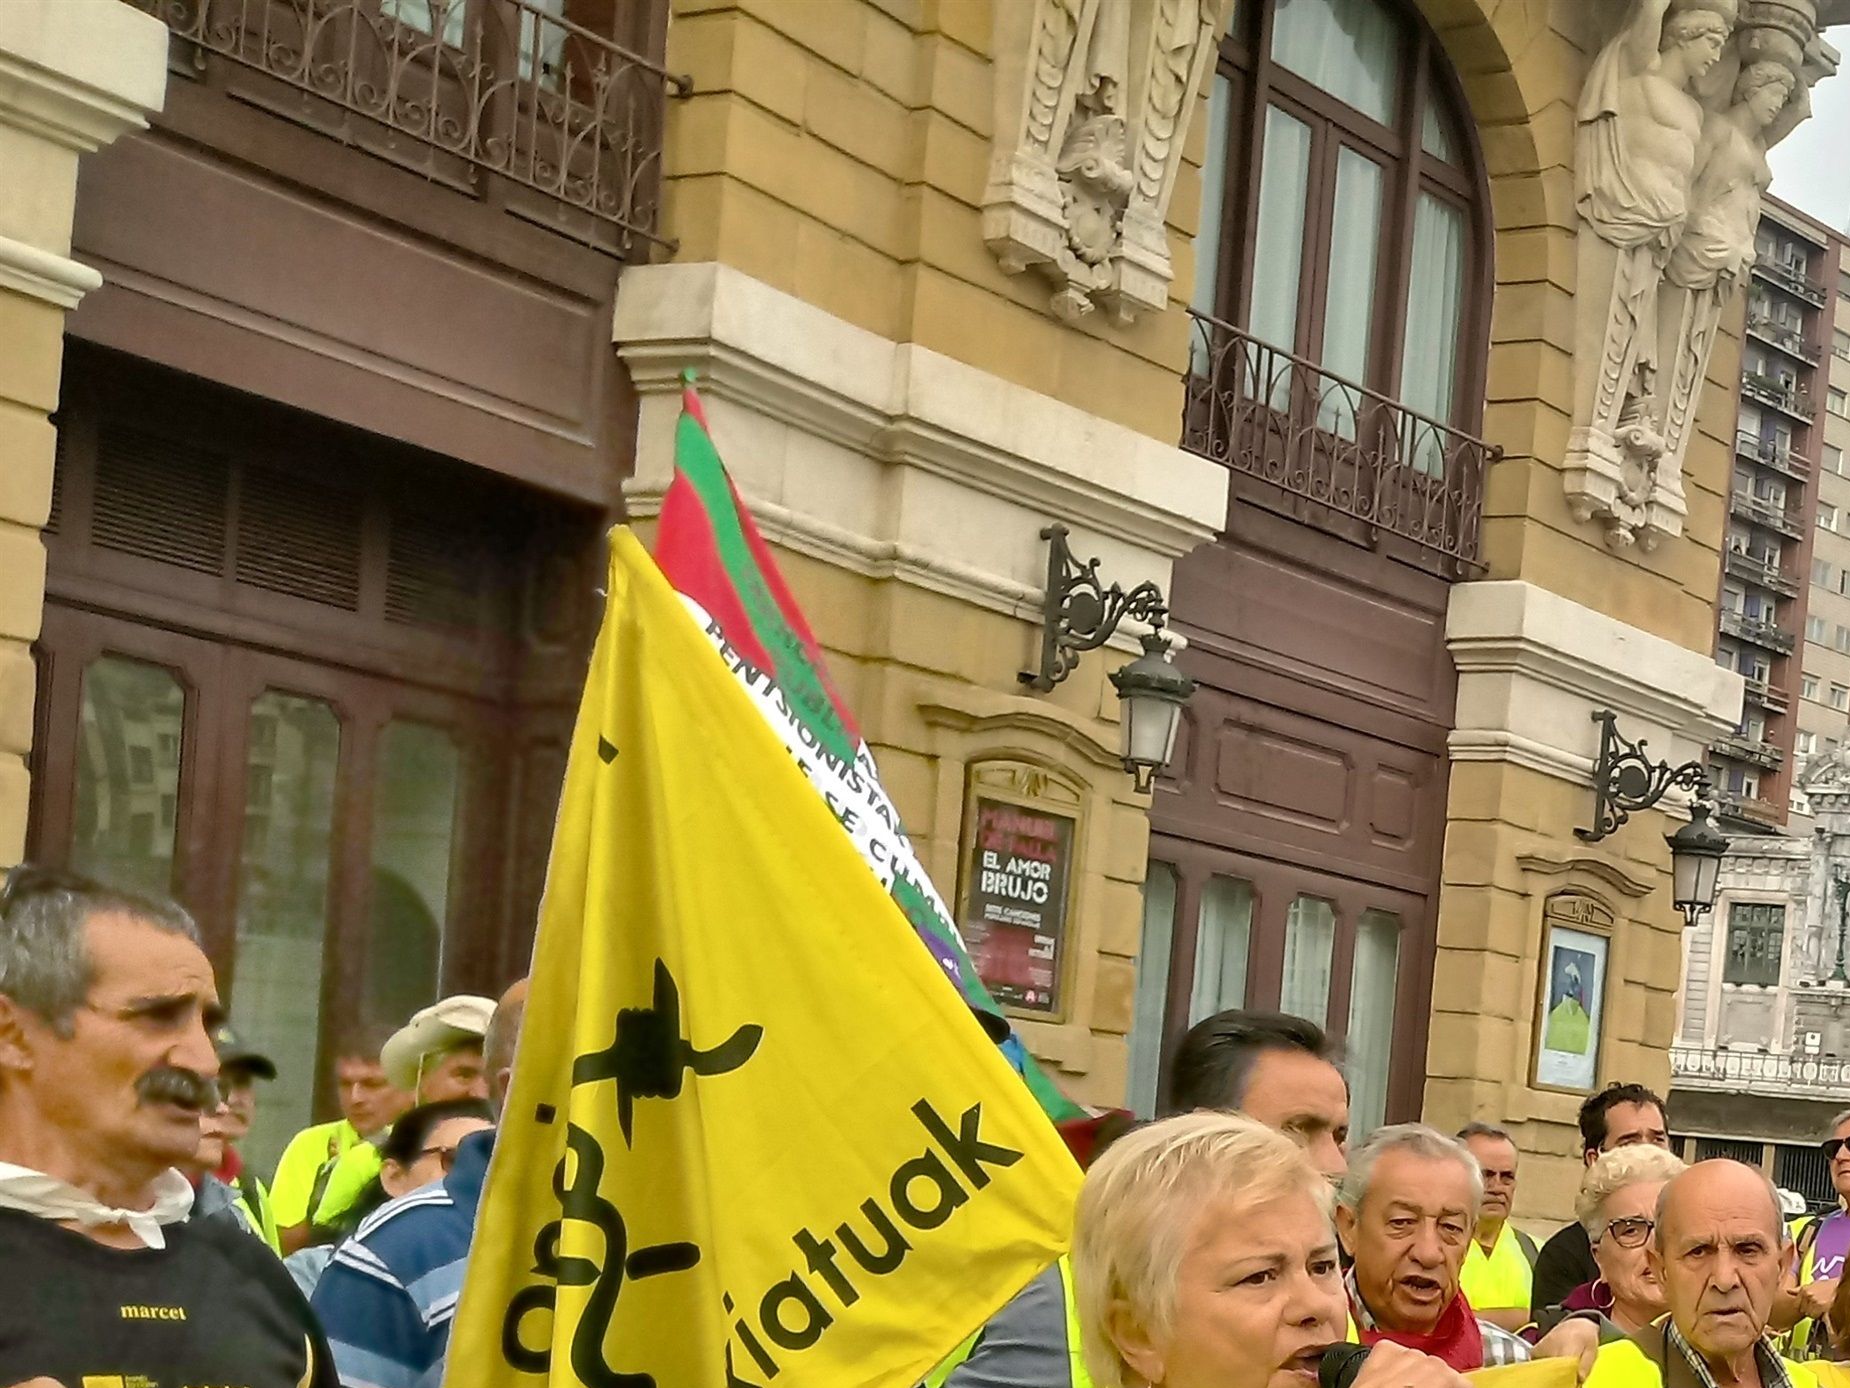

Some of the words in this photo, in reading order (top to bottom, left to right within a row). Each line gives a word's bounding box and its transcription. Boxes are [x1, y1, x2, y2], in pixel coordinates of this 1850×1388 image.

[983, 850, 1001, 870] EL
[1006, 857, 1051, 881] AMOR
[981, 870, 1049, 904] BRUJO
